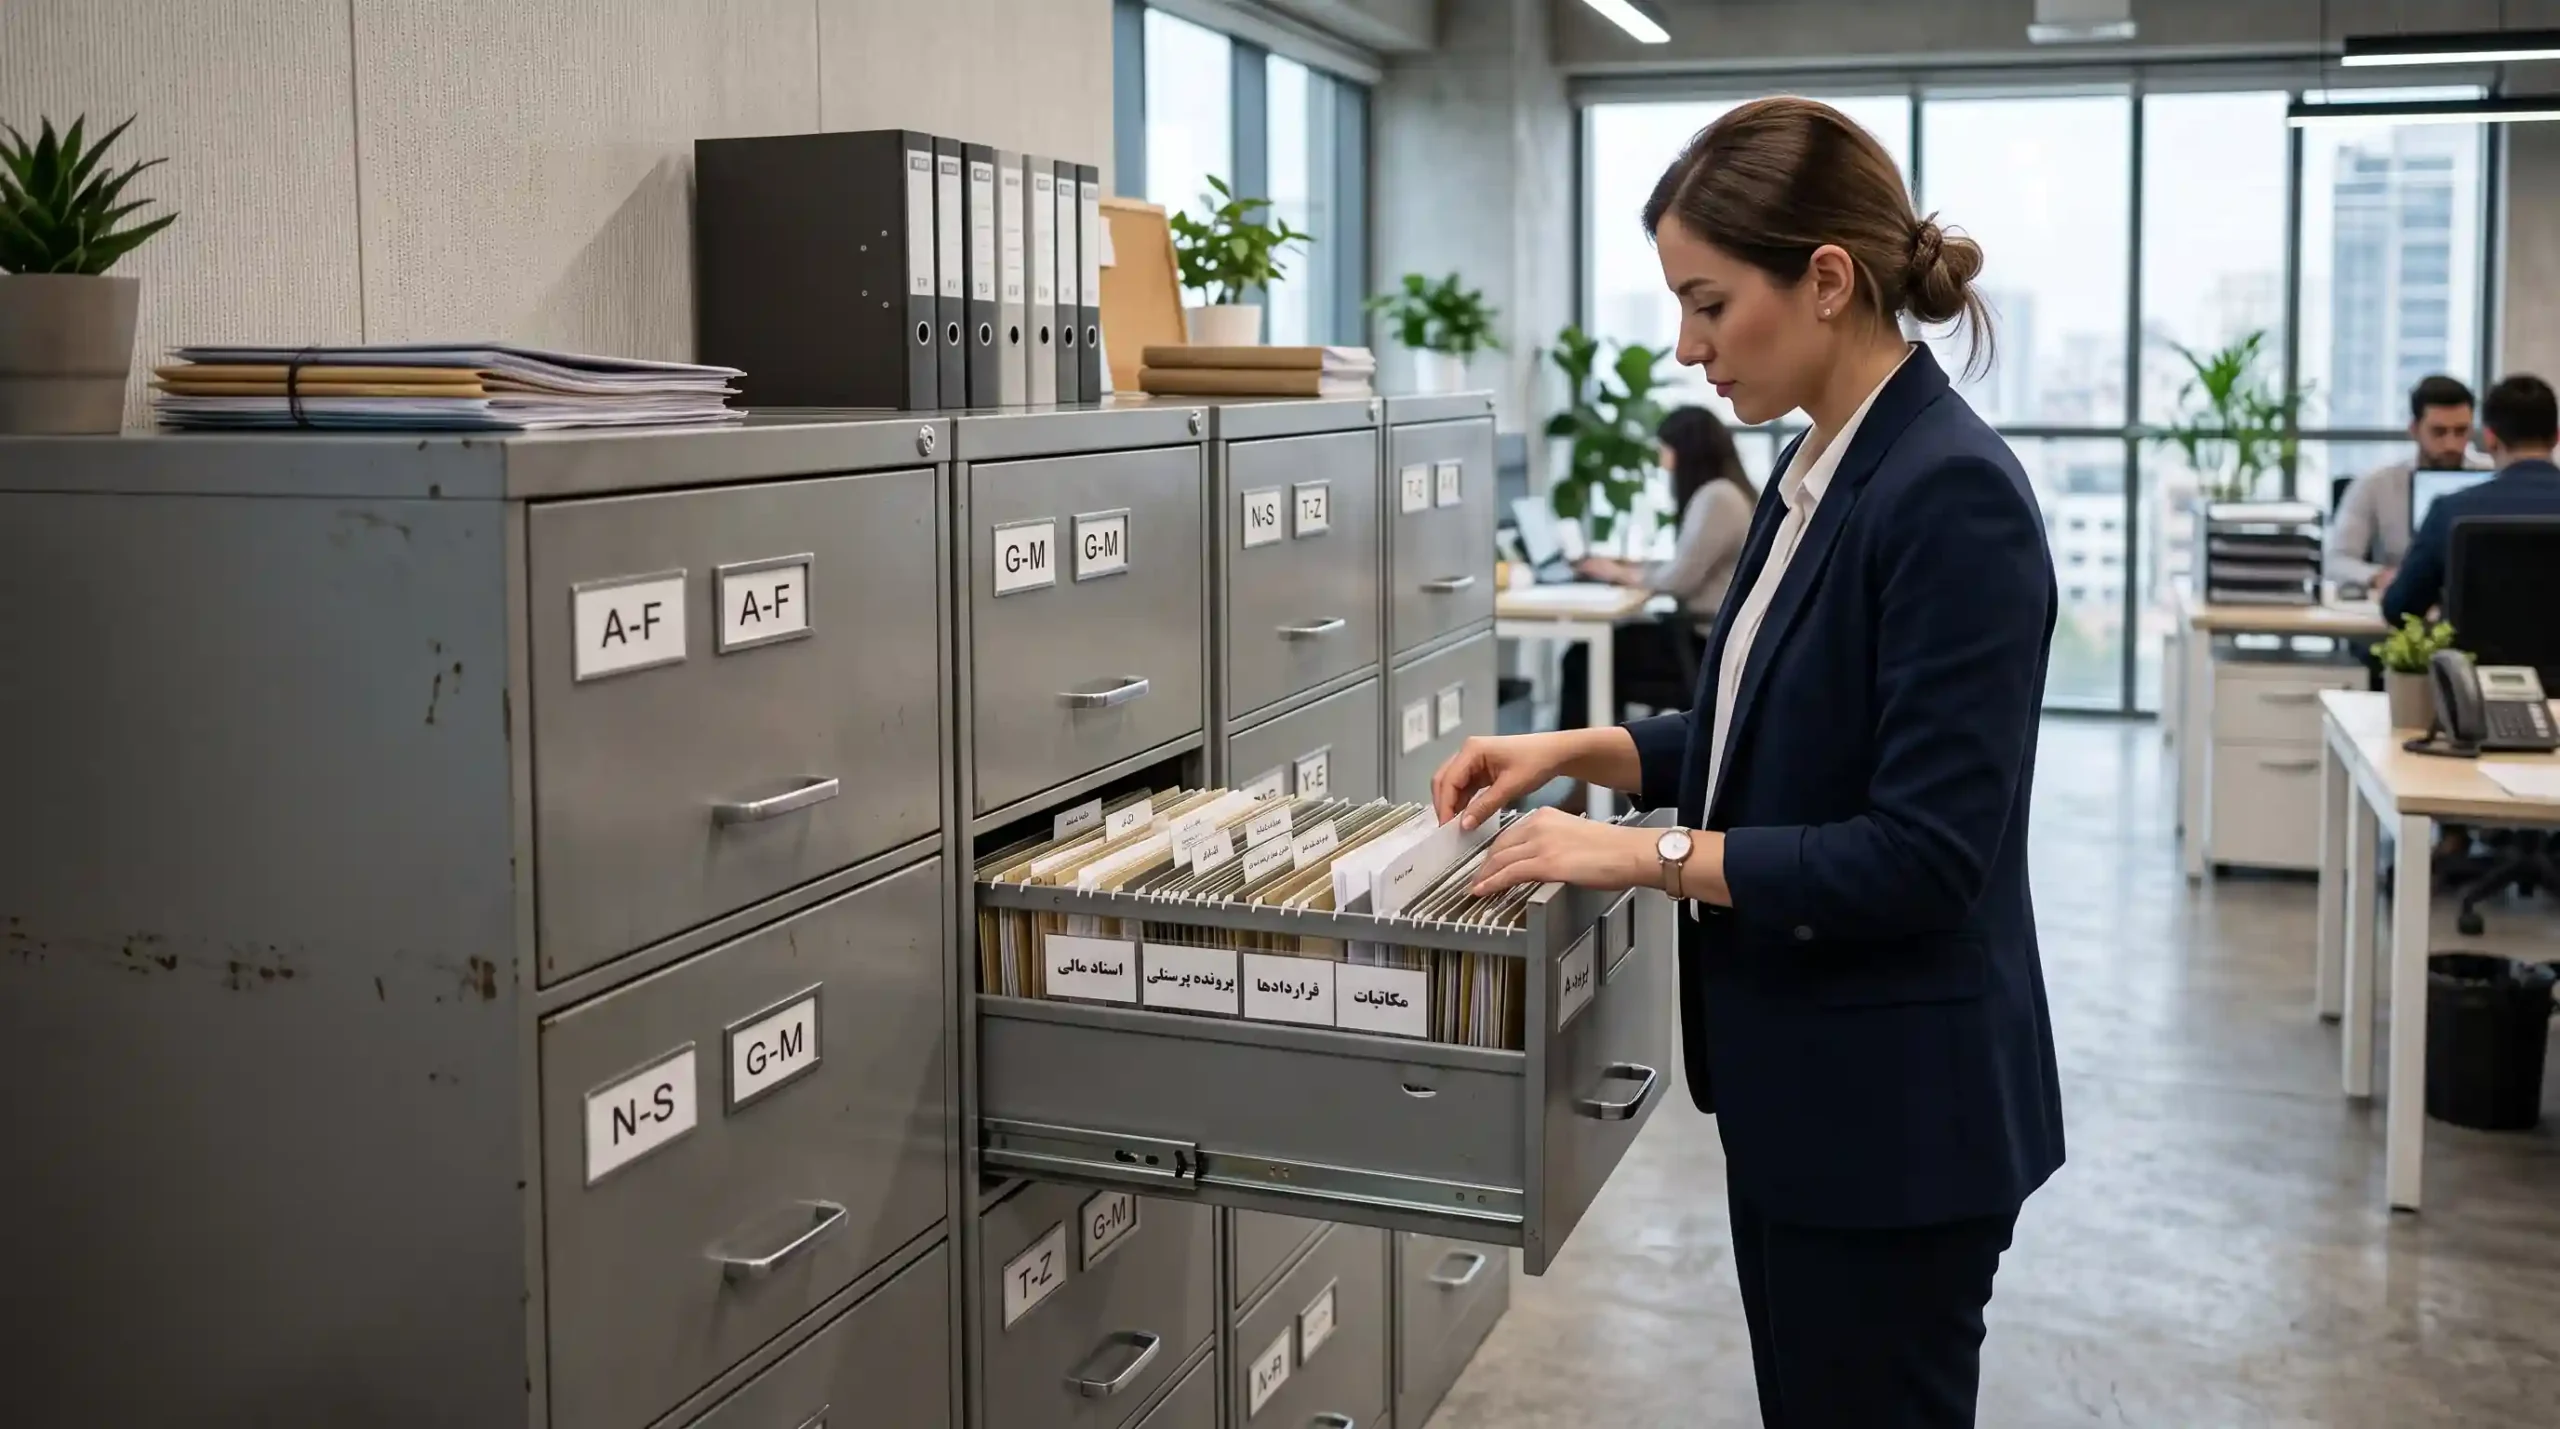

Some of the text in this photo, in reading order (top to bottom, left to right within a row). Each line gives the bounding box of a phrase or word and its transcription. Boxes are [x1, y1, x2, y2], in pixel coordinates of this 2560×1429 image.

[1252, 503, 1274, 527] N-S
[1302, 498, 1321, 519] T-Z
[1005, 540, 1045, 573] G-M
[1084, 530, 1118, 560] G-M
[739, 583, 790, 626] A-F
[602, 601, 662, 648] A-F
[1057, 958, 1123, 976] اسناد مالی
[1193, 972, 1234, 993] پرونده
[1257, 978, 1320, 1001] قراردادها
[1353, 989, 1409, 1009] مکاتبات
[746, 1021, 803, 1076] G-M
[613, 1082, 674, 1145] N-S
[1093, 1196, 1126, 1240] G-M
[1018, 1249, 1053, 1299] T-Z
